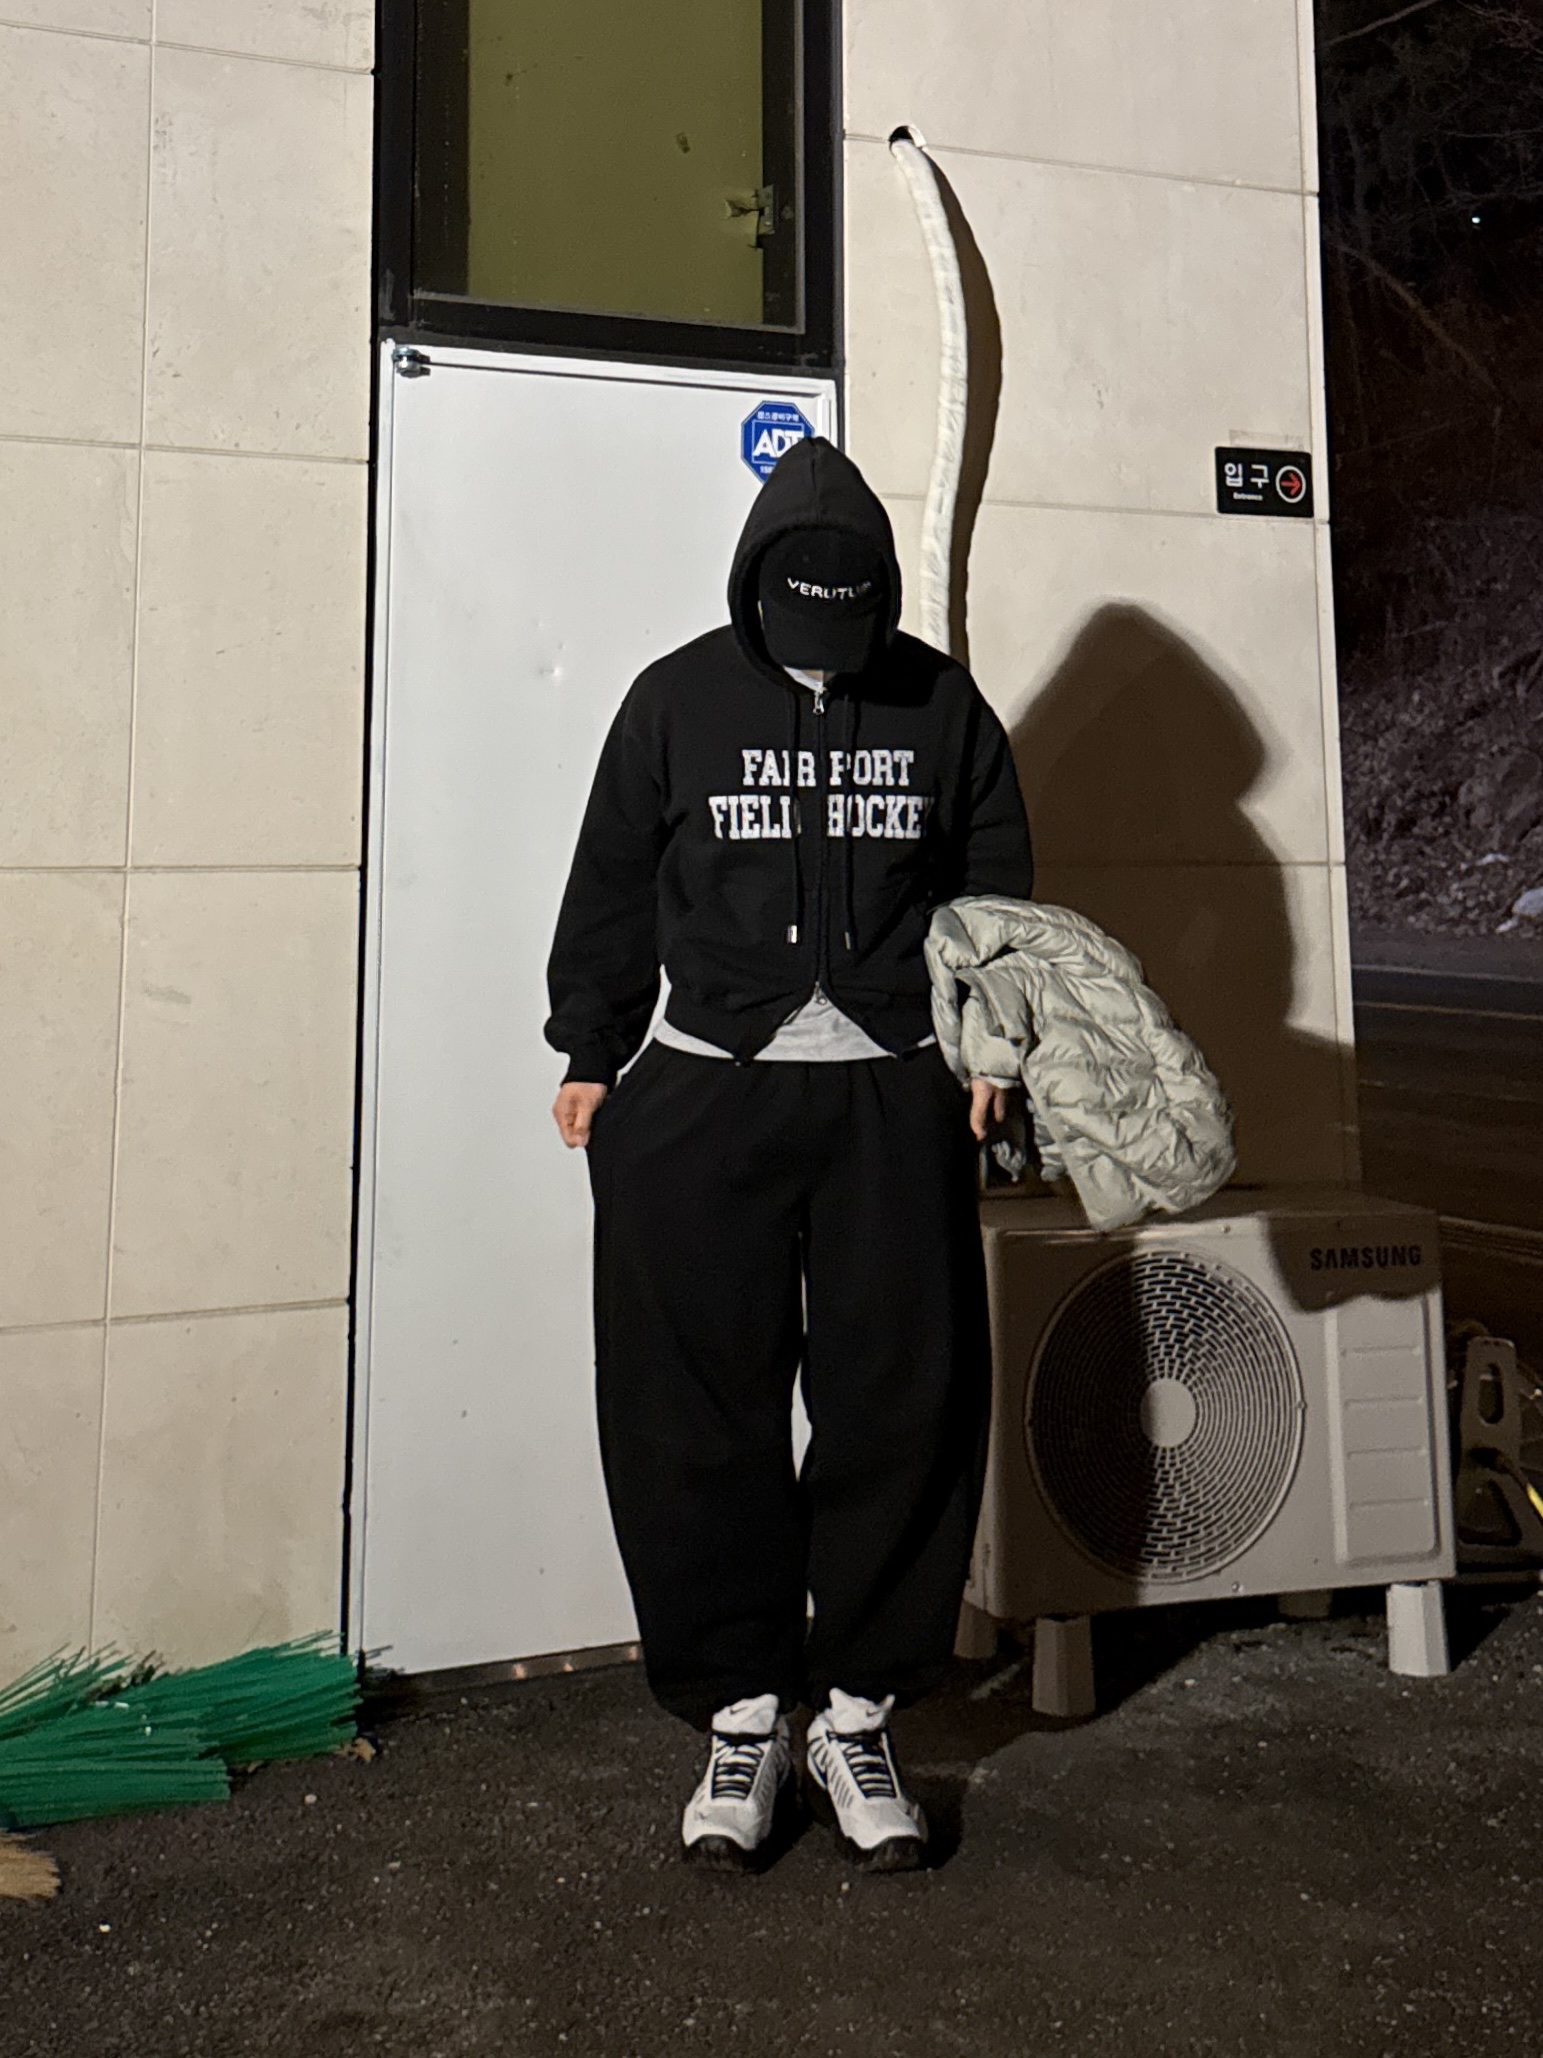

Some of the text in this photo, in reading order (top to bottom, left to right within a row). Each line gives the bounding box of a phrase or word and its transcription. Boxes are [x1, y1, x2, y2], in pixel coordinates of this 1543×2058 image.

[752, 428, 805, 459] ADT
[1224, 462, 1270, 489] 입구
[1310, 1245, 1421, 1270] SAMSUNG
